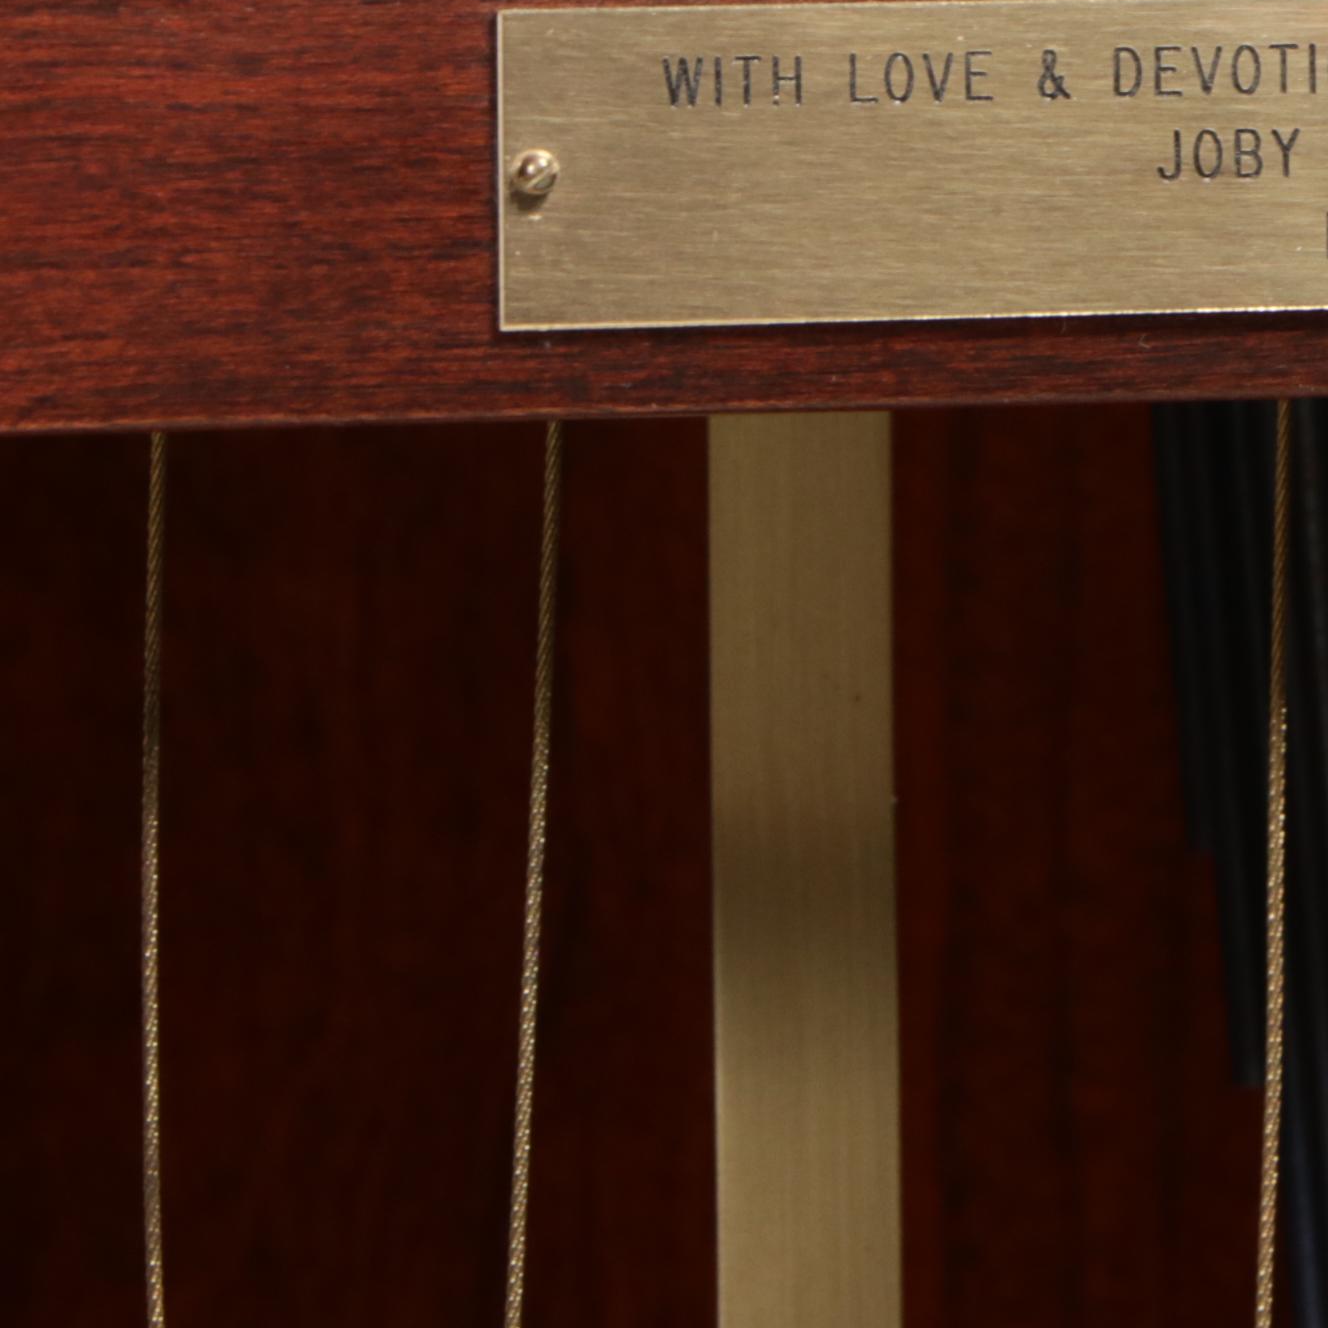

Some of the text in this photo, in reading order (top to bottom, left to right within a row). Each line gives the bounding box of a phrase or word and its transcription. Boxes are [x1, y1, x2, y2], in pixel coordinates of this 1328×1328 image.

[662, 55, 803, 107] WITH
[849, 50, 994, 104] LOVE
[1037, 49, 1071, 101] &
[1156, 128, 1300, 182] JOBY
